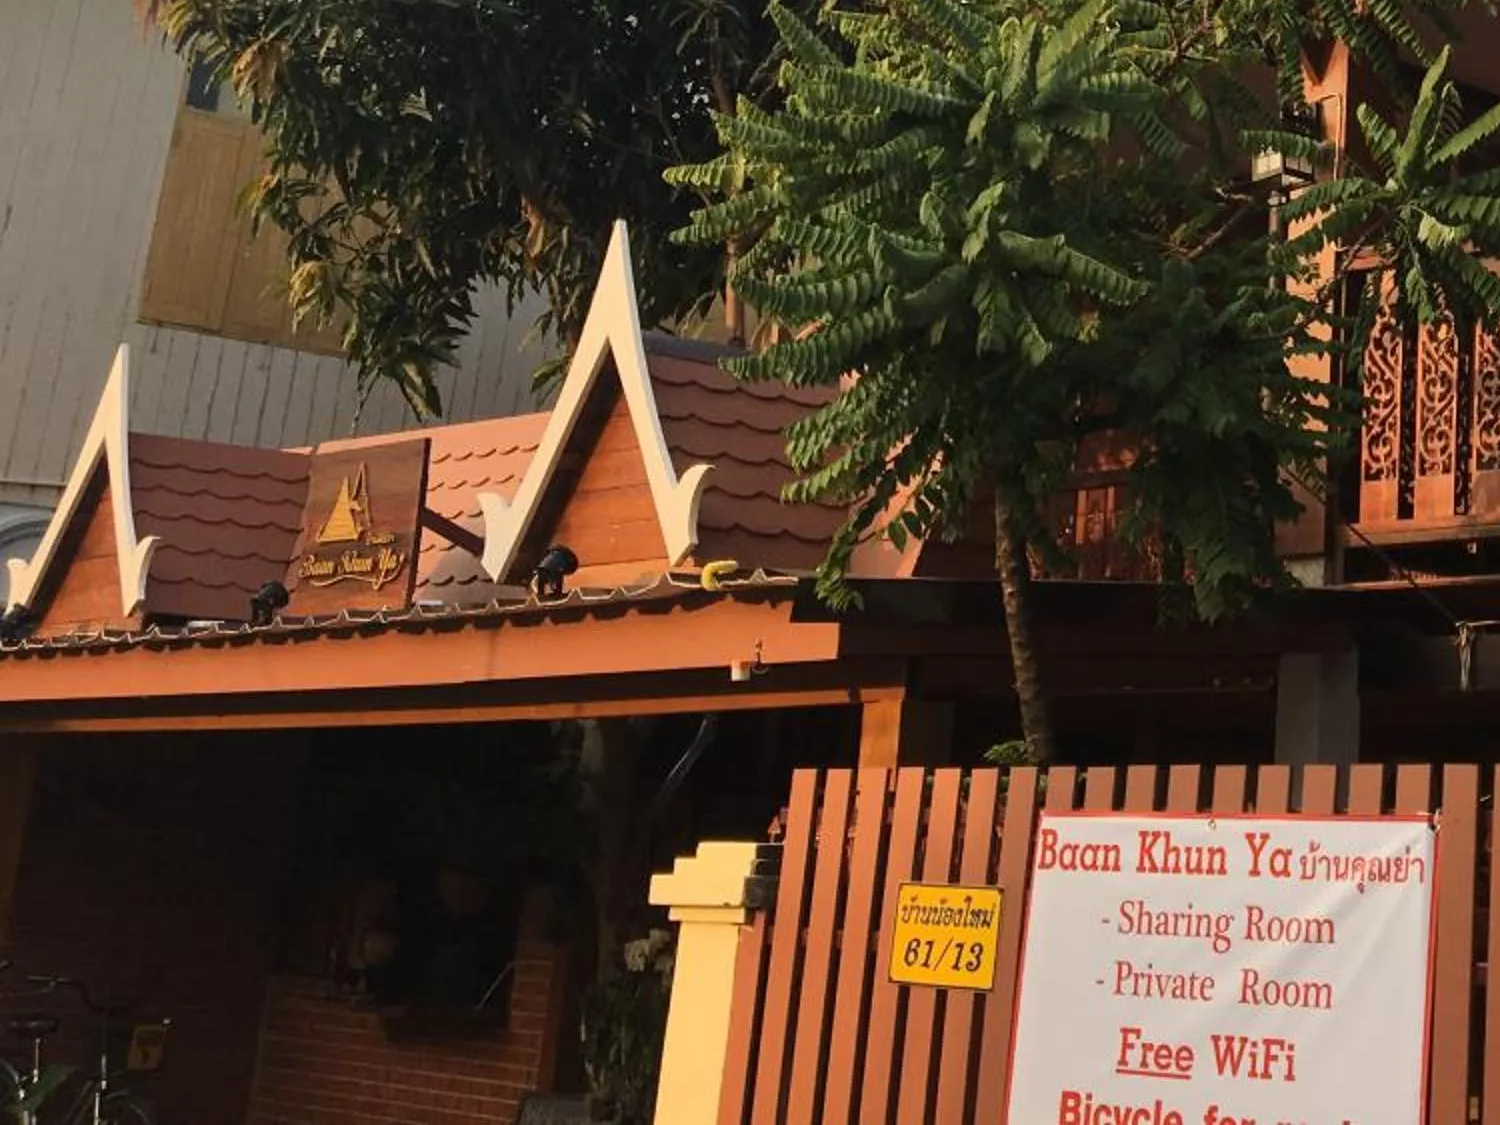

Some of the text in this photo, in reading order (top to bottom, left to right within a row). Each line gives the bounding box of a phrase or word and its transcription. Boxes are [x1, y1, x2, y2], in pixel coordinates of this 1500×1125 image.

[1038, 828, 1293, 878] Baan Khun Ya
[1300, 840, 1425, 894] บ้านคุณย่า
[1244, 905, 1336, 944] Room
[904, 937, 984, 973] 61/13
[1238, 968, 1333, 1010] Room
[1116, 1027, 1296, 1082] Free WiFi
